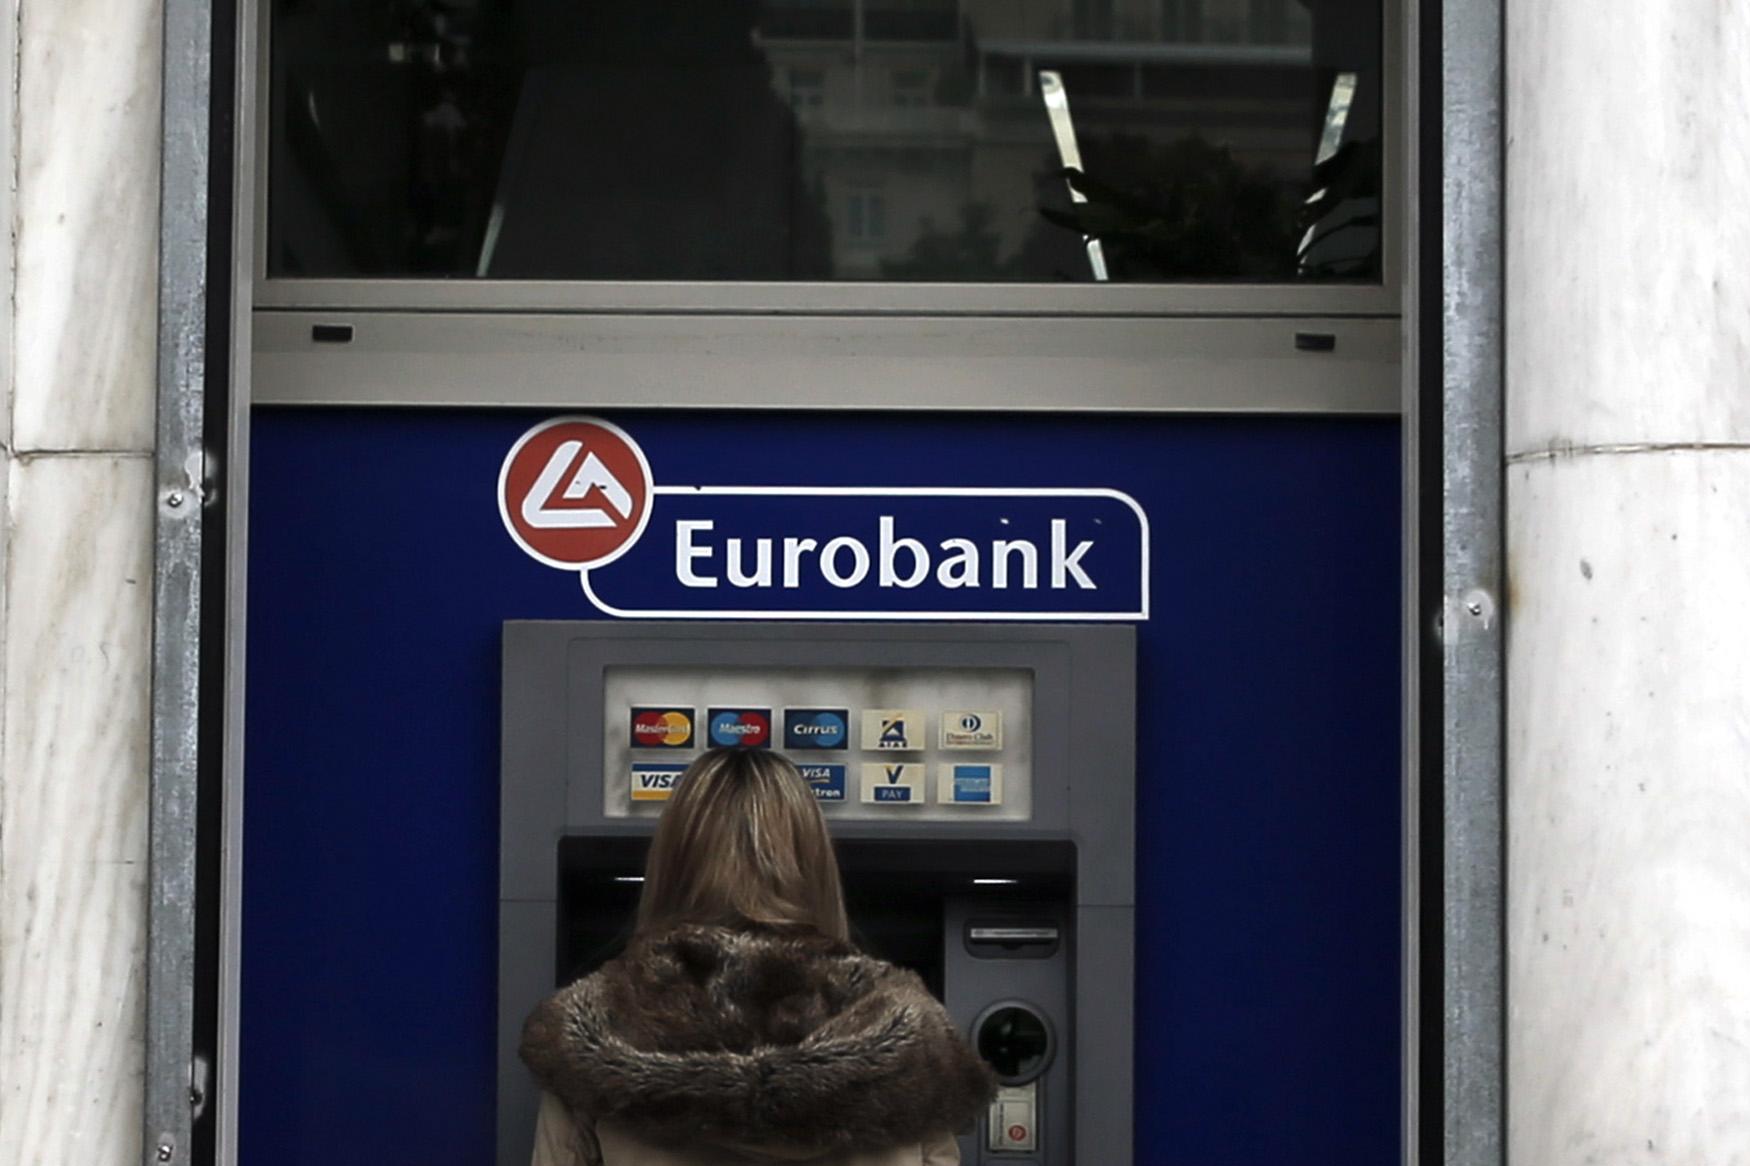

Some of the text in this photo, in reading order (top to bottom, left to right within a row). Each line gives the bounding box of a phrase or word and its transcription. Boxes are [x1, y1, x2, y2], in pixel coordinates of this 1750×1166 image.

[675, 515, 1097, 590] Eurobank
[719, 722, 761, 734] Maestro
[793, 723, 838, 735] Cirrus
[802, 767, 831, 778] VISA
[881, 789, 903, 799] PAY
